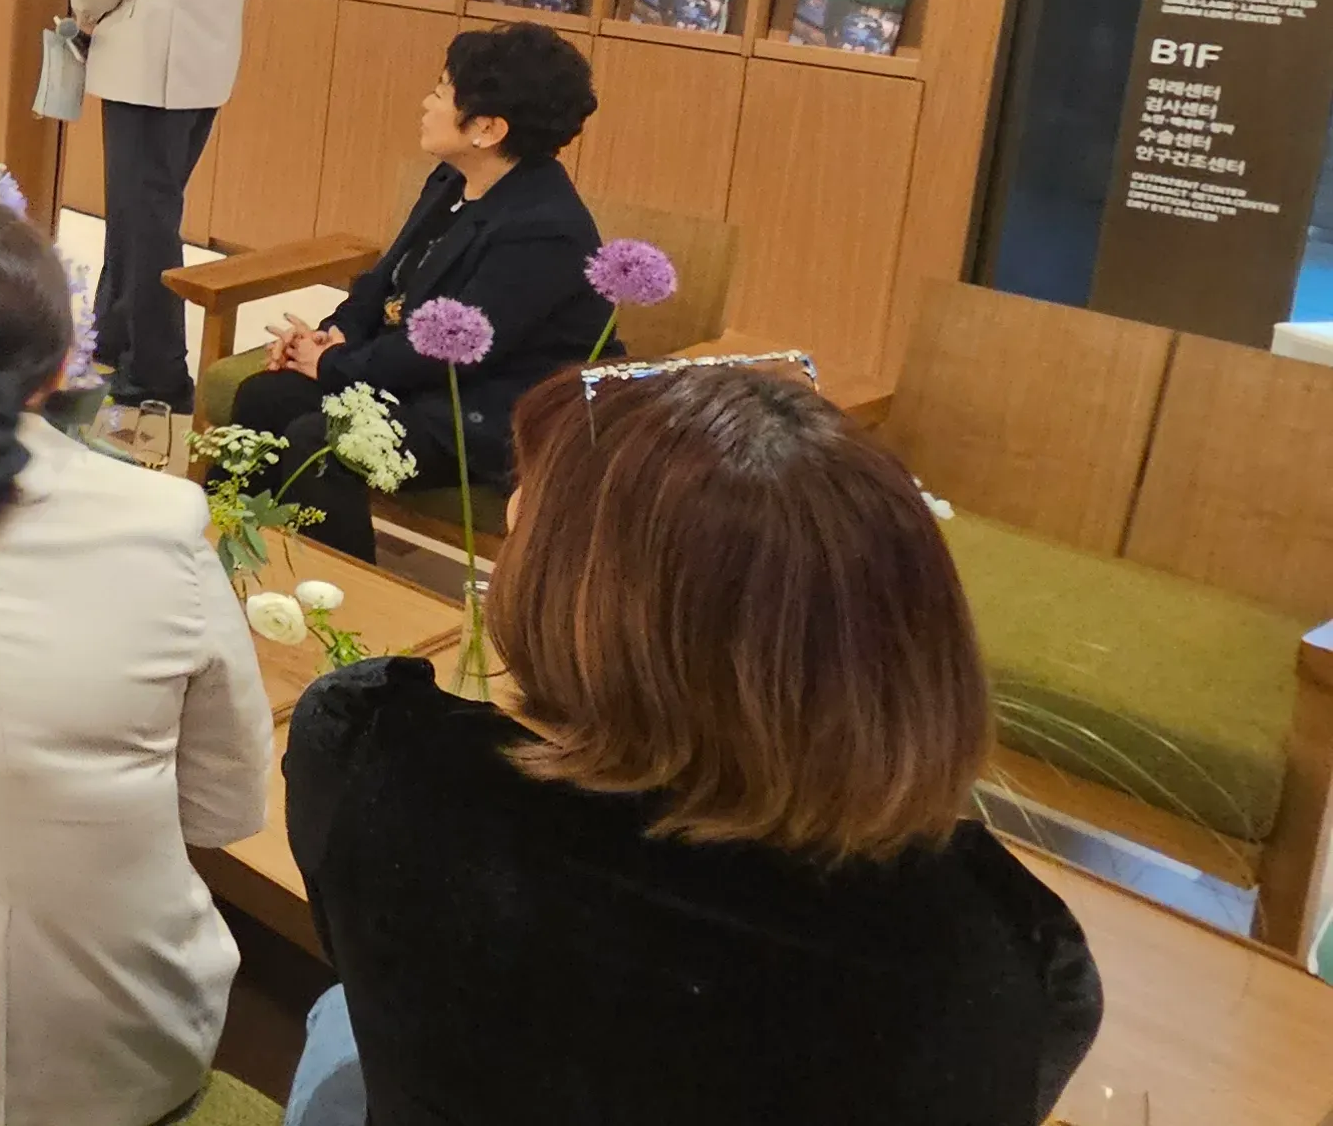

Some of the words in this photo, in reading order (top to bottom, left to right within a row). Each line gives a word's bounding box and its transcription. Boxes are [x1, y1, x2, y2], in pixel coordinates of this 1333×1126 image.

[1234, 12, 1282, 25] CENTER
[1150, 38, 1223, 69] B1F
[1147, 77, 1221, 101] 외래센터
[1145, 96, 1217, 120] 검사센터
[1139, 127, 1212, 152] 수술센터
[1136, 145, 1246, 176] 안구건조센터
[1200, 183, 1247, 197] CENTER
[1173, 207, 1218, 222] CENTER
[1191, 201, 1237, 215] CENTER
[1233, 198, 1280, 213] CENTER
